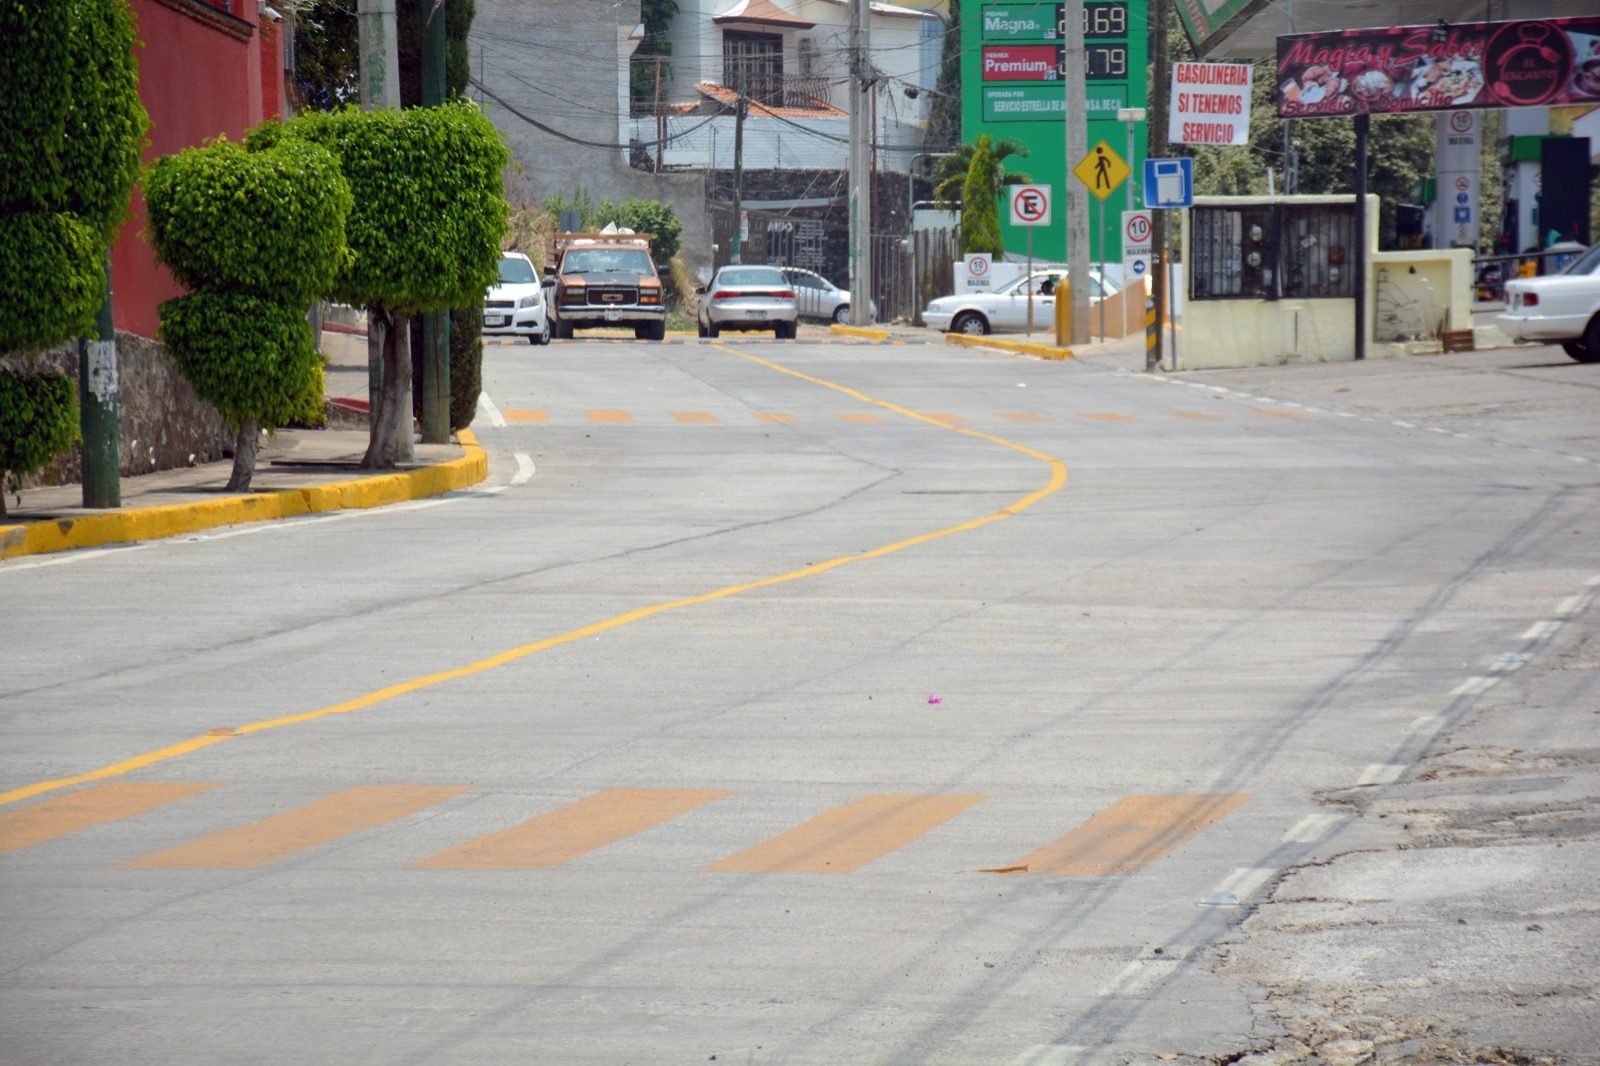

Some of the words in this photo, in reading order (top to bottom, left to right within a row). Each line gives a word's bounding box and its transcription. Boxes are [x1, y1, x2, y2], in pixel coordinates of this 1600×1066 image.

[985, 18, 1035, 34] Magna
[985, 59, 1047, 72] Premium
[1278, 41, 1371, 73] Magia
[1376, 42, 1393, 68] y
[1177, 64, 1248, 85] GASOLINERIA
[1178, 93, 1190, 113] SI
[1192, 93, 1242, 115] TENEMOS
[1283, 97, 1353, 116] Servicio
[1183, 122, 1234, 143] SERVICIO
[1024, 195, 1037, 214] E
[1131, 221, 1147, 234] 10
[973, 261, 984, 269] 10
